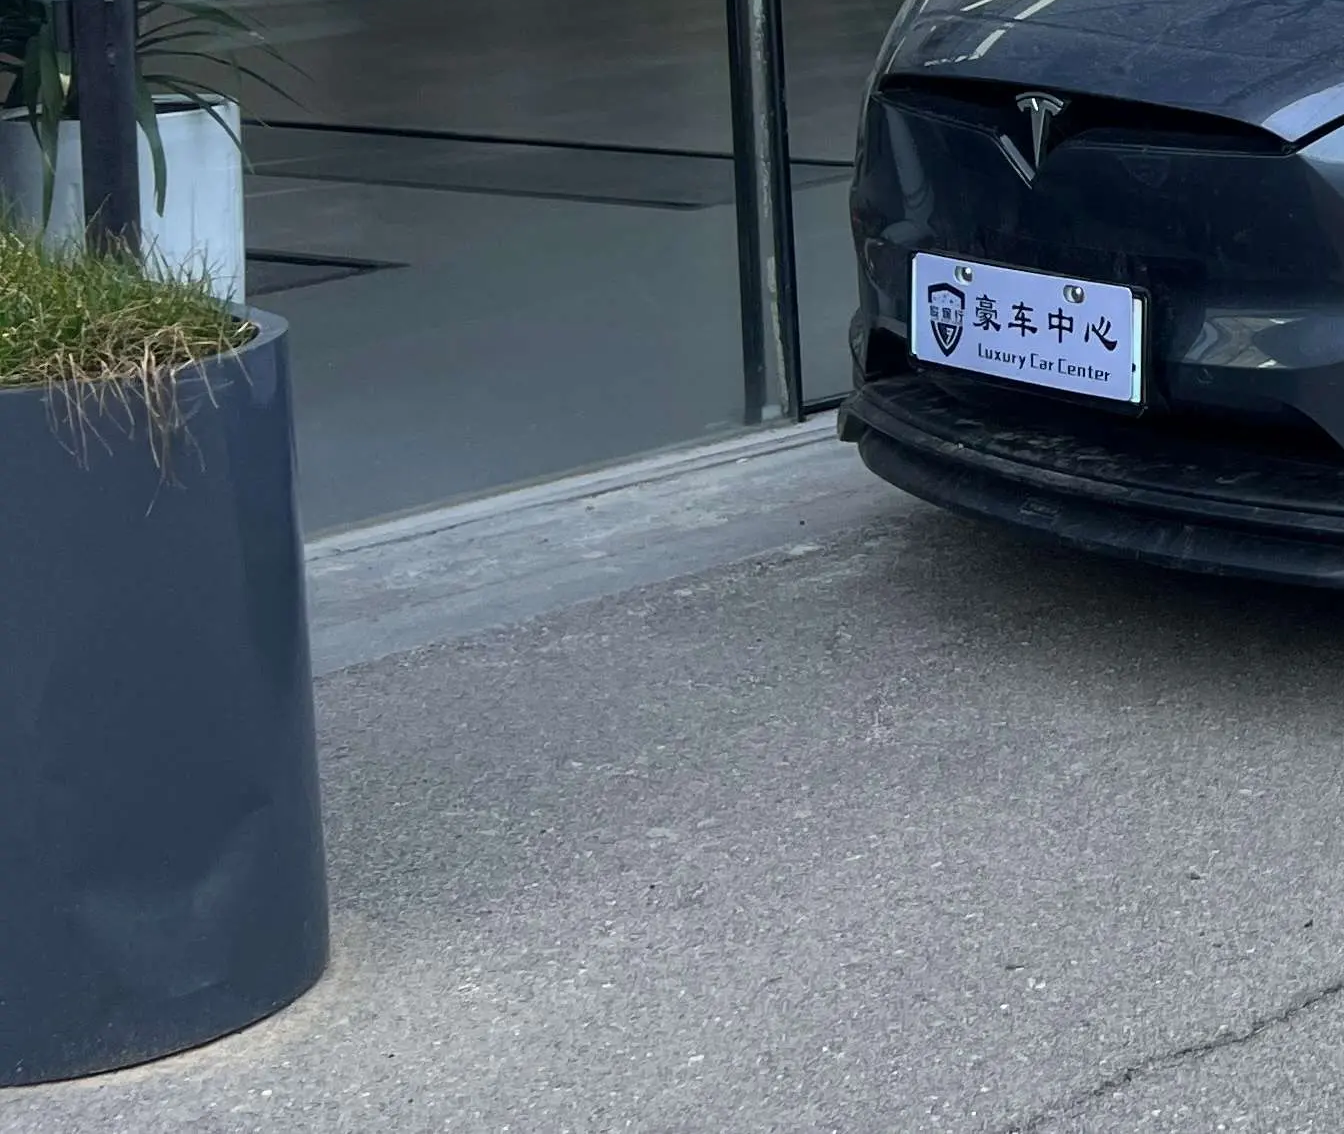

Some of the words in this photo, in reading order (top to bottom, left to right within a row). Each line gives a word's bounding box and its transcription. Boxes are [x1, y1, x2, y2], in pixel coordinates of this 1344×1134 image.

[973, 293, 1118, 352] 豪车中心
[977, 342, 1026, 370] Luxury
[1030, 352, 1054, 371] Car
[1057, 358, 1111, 382] Center
